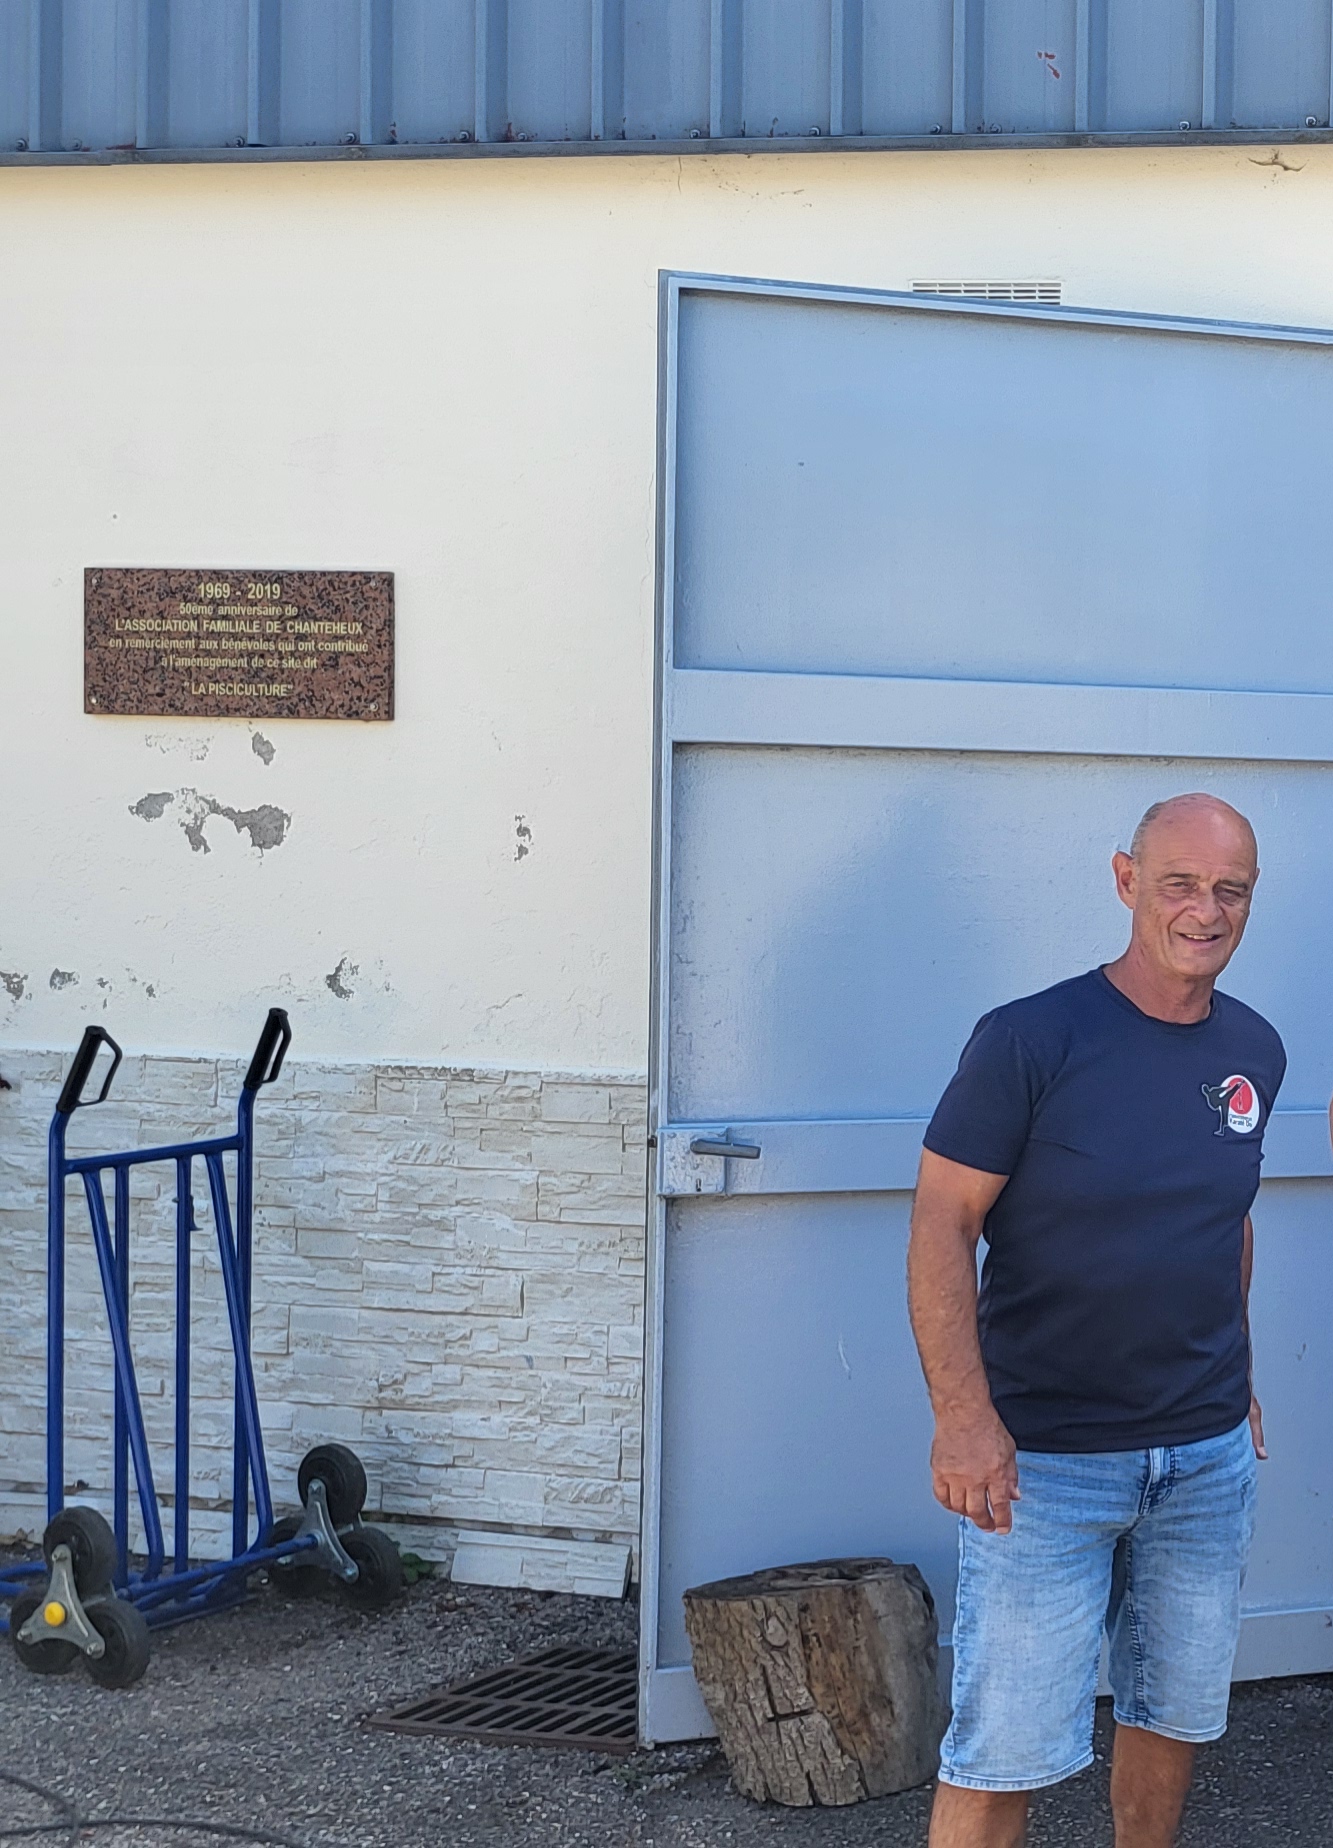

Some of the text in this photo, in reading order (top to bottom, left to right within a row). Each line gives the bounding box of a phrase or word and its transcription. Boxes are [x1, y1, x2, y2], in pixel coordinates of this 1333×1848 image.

[198, 582, 231, 599] 1969
[247, 583, 281, 600] 2019
[217, 603, 283, 616] anniversaire
[284, 604, 299, 616] de
[115, 619, 364, 635] L'ASSOCIATION FAMILIALE DE CHANTEHEUX
[109, 636, 369, 653] en remerciement aux bénévoles qui ont contribué
[169, 655, 248, 670] l'aménagement
[251, 657, 265, 669] de
[267, 658, 279, 669] ce
[281, 656, 301, 669] site
[303, 656, 318, 670] dit
